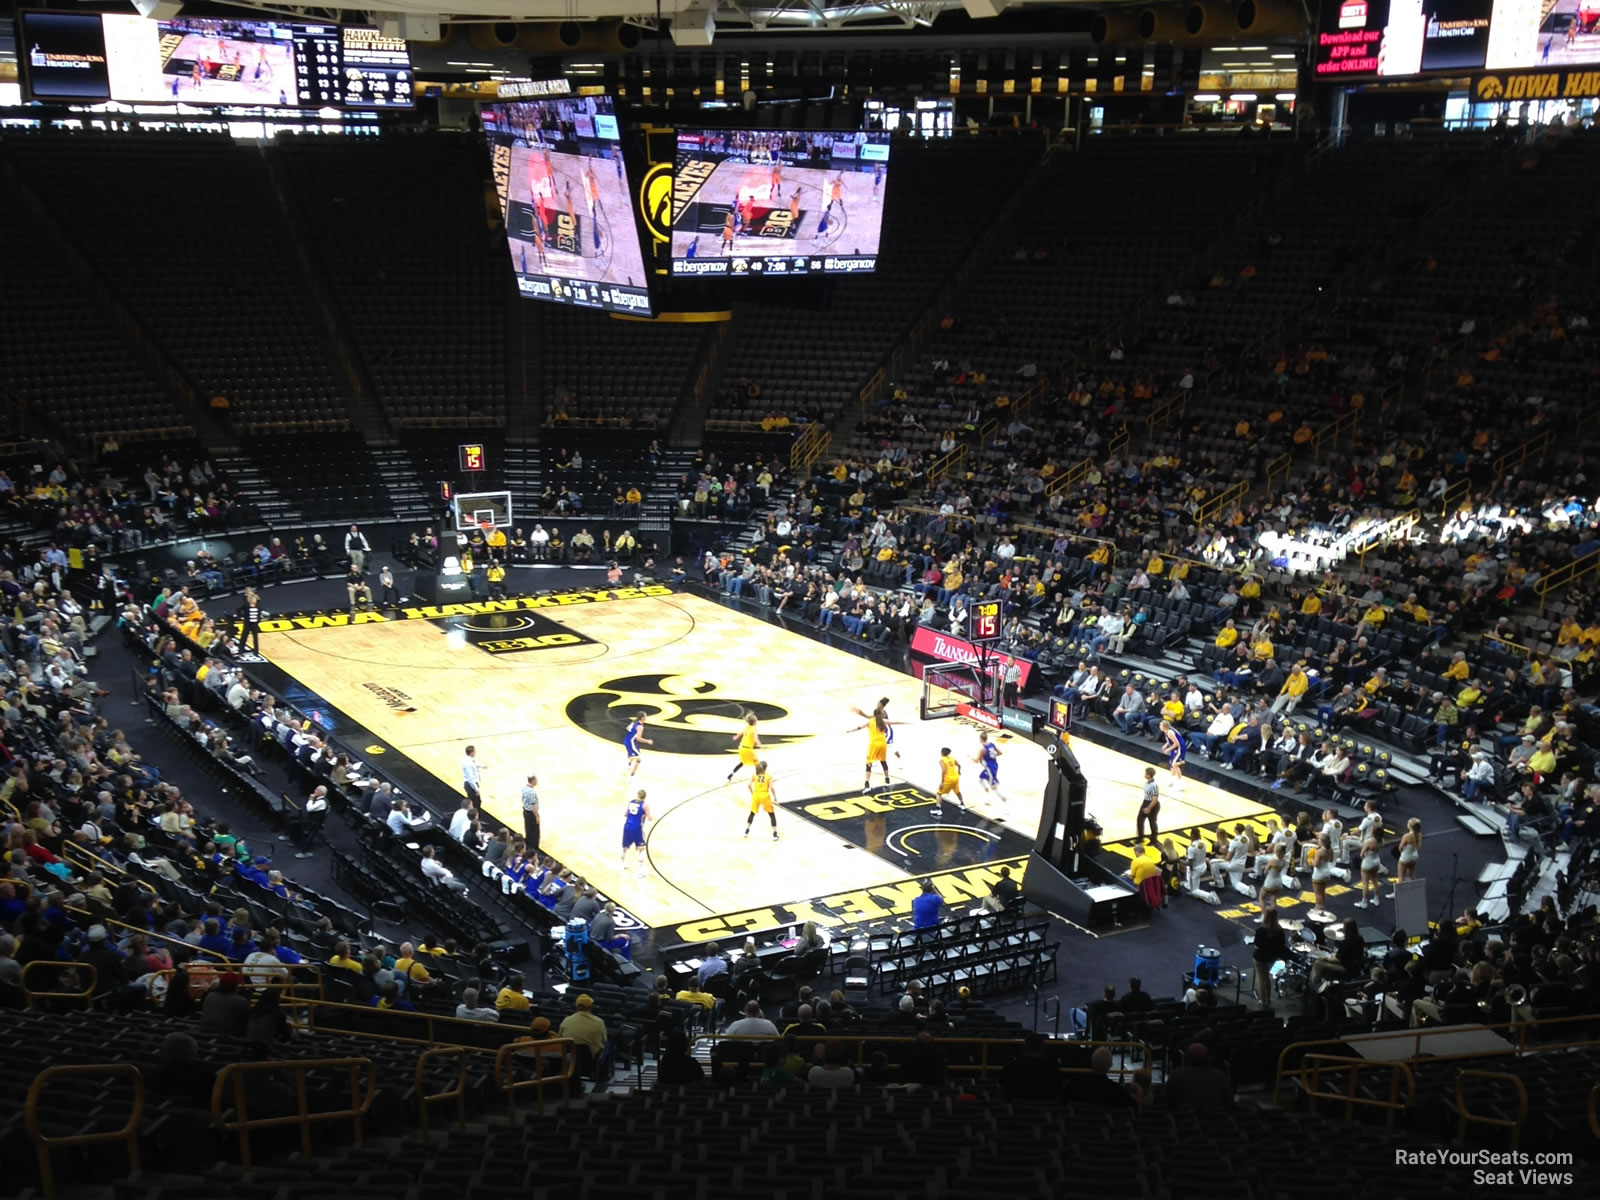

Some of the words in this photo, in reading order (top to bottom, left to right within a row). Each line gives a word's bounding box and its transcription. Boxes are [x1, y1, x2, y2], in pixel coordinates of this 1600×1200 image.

[1320, 30, 1363, 45] Download
[1363, 31, 1379, 41] our
[344, 41, 369, 49] HOME
[371, 43, 406, 51] EVENTS
[1330, 46, 1350, 57] APP
[1350, 44, 1367, 56] and
[1317, 61, 1340, 73] order
[1504, 73, 1559, 98] IOWA
[751, 262, 762, 271] 49
[468, 455, 480, 468] 15
[402, 585, 673, 619] HAWKEYES
[979, 603, 998, 616] 7:08
[981, 616, 995, 635] 15
[675, 860, 1029, 943] AWKEYES
